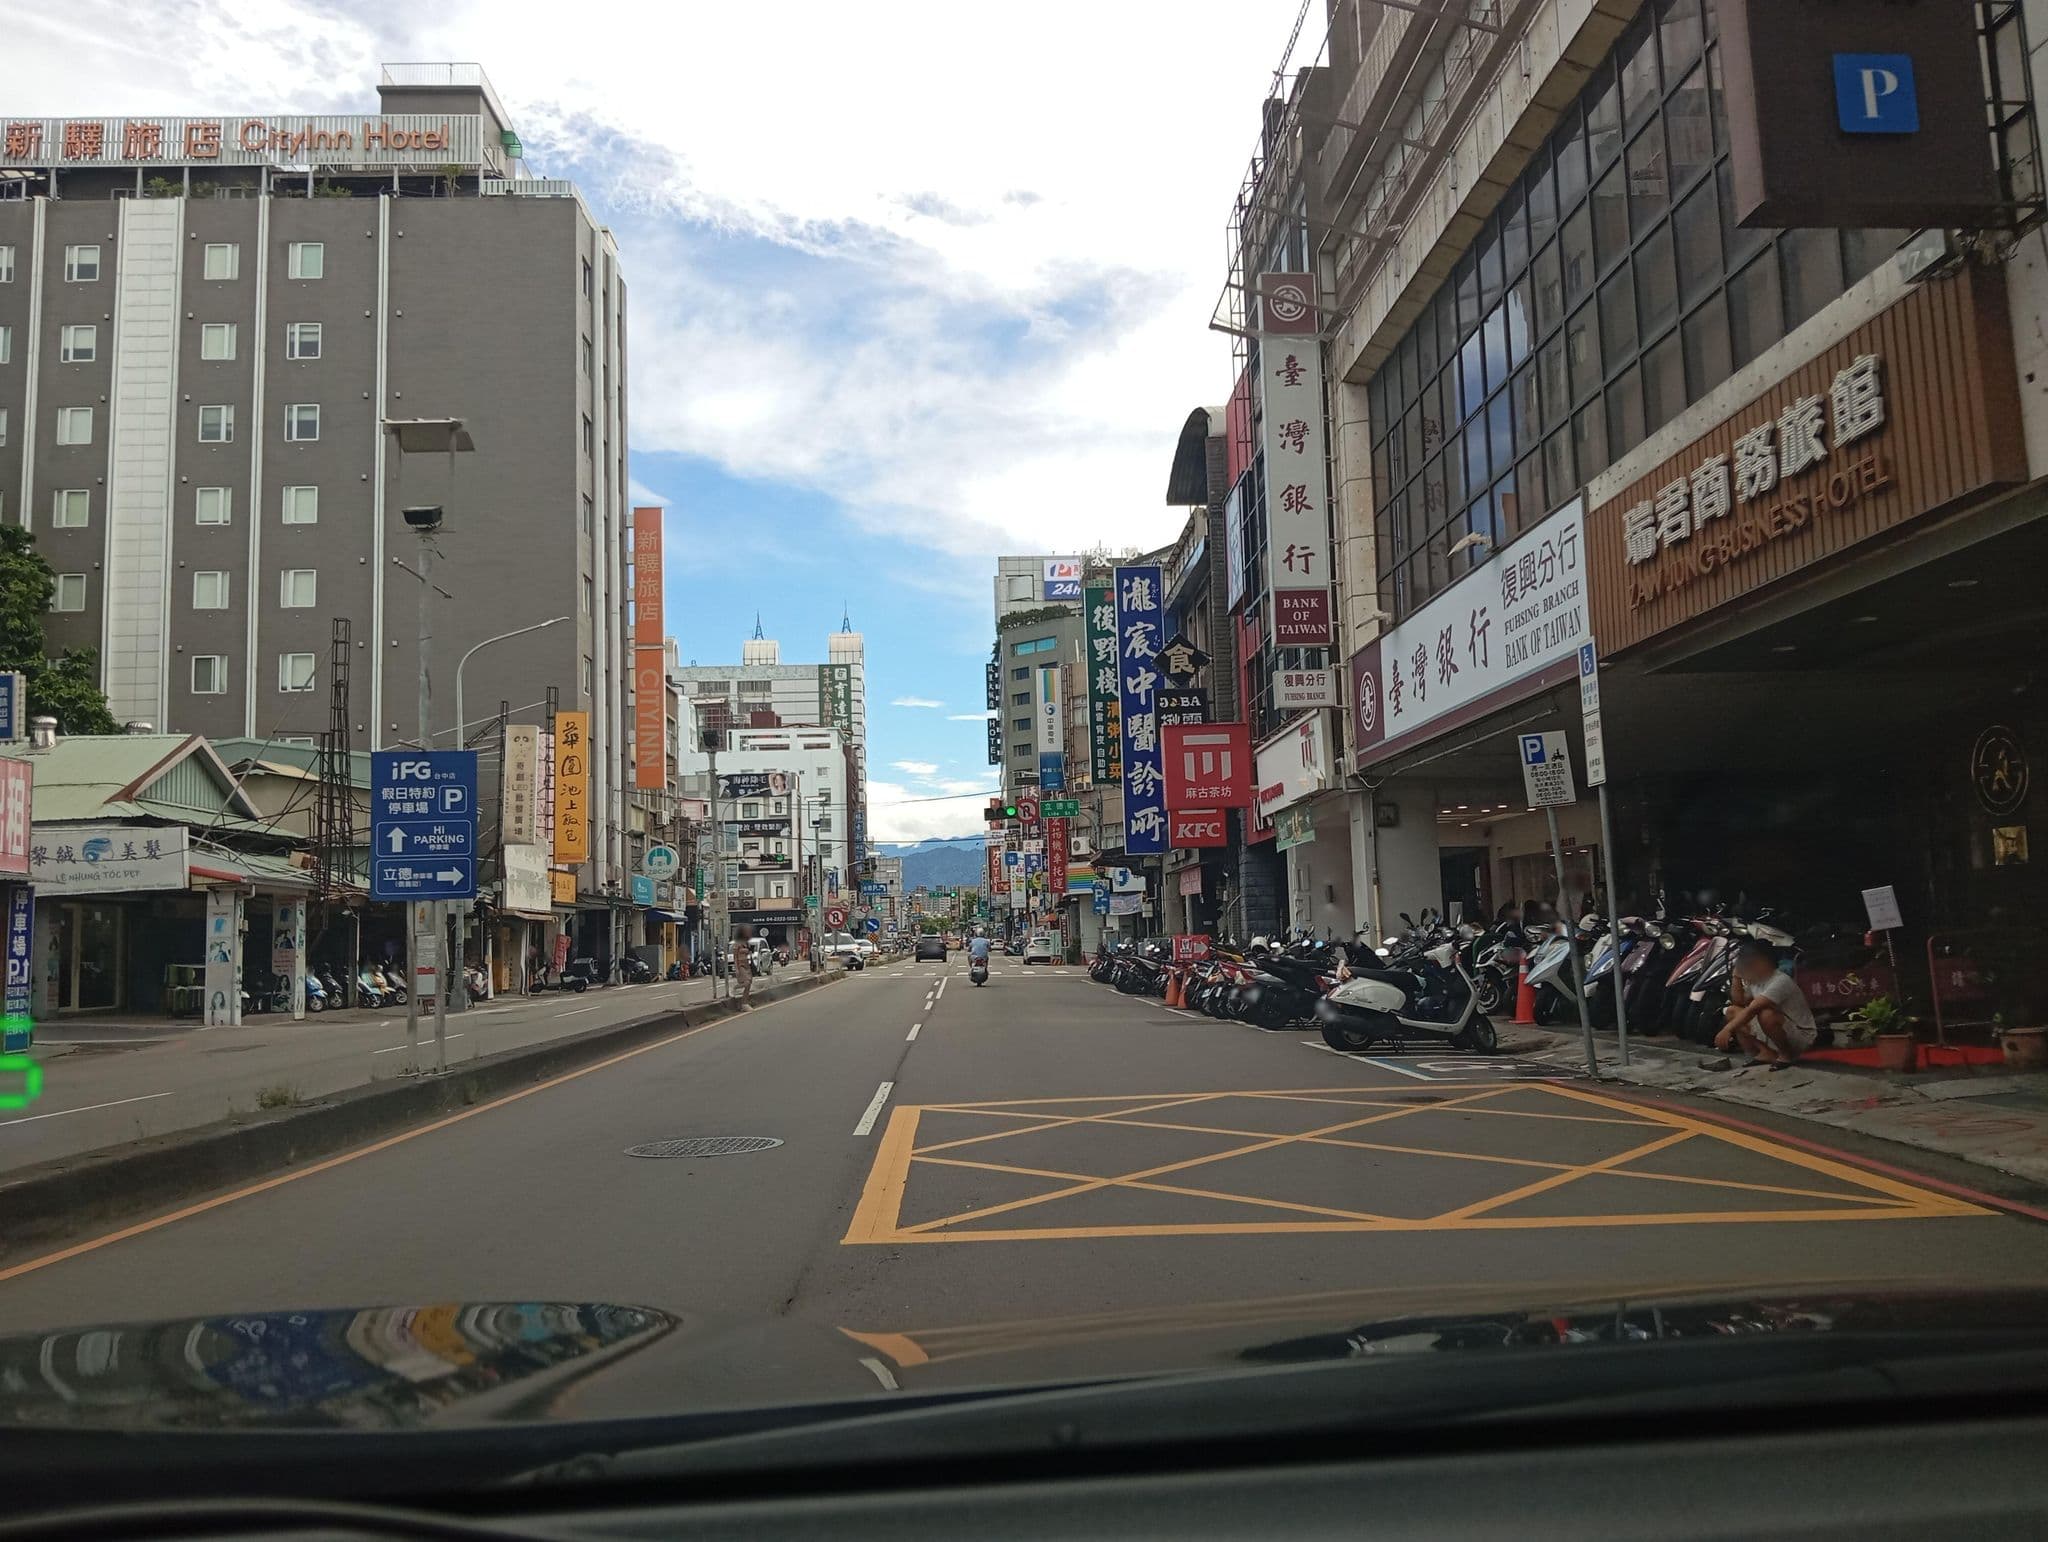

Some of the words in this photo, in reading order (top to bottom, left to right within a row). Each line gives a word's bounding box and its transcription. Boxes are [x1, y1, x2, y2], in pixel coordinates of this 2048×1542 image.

[1857, 68, 1899, 119] P
[6, 121, 221, 160] 新驛旅店
[363, 121, 449, 151] Hotel
[1275, 354, 1315, 575] 臺灣銀行
[1719, 494, 1809, 564] BUSINESS
[1814, 454, 1889, 518] HOTEL
[637, 530, 658, 621] 新驛旅店
[1501, 522, 1578, 611] 復興分行
[1283, 597, 1319, 609] BANK
[1504, 603, 1540, 636] FUHSING
[1542, 579, 1580, 614] BRANCH
[1292, 611, 1309, 621] OF
[1279, 624, 1327, 634] TAIWAN
[1504, 636, 1529, 669] BANK
[1530, 630, 1543, 655] OF
[1543, 605, 1583, 649] TAIWAN
[1164, 643, 1196, 674] 食
[1388, 606, 1491, 718] 臺灣銀行
[1284, 673, 1326, 687] 復興分行
[1524, 738, 1543, 763] P
[382, 787, 435, 800] 假日特約
[444, 788, 463, 810] P
[1185, 786, 1233, 799] 麻古茶坊
[388, 802, 429, 815] 停車場
[414, 835, 465, 844] PARKING
[1175, 822, 1222, 839] KFC
[121, 839, 162, 861] 美髮
[12, 888, 29, 957] 停車場
